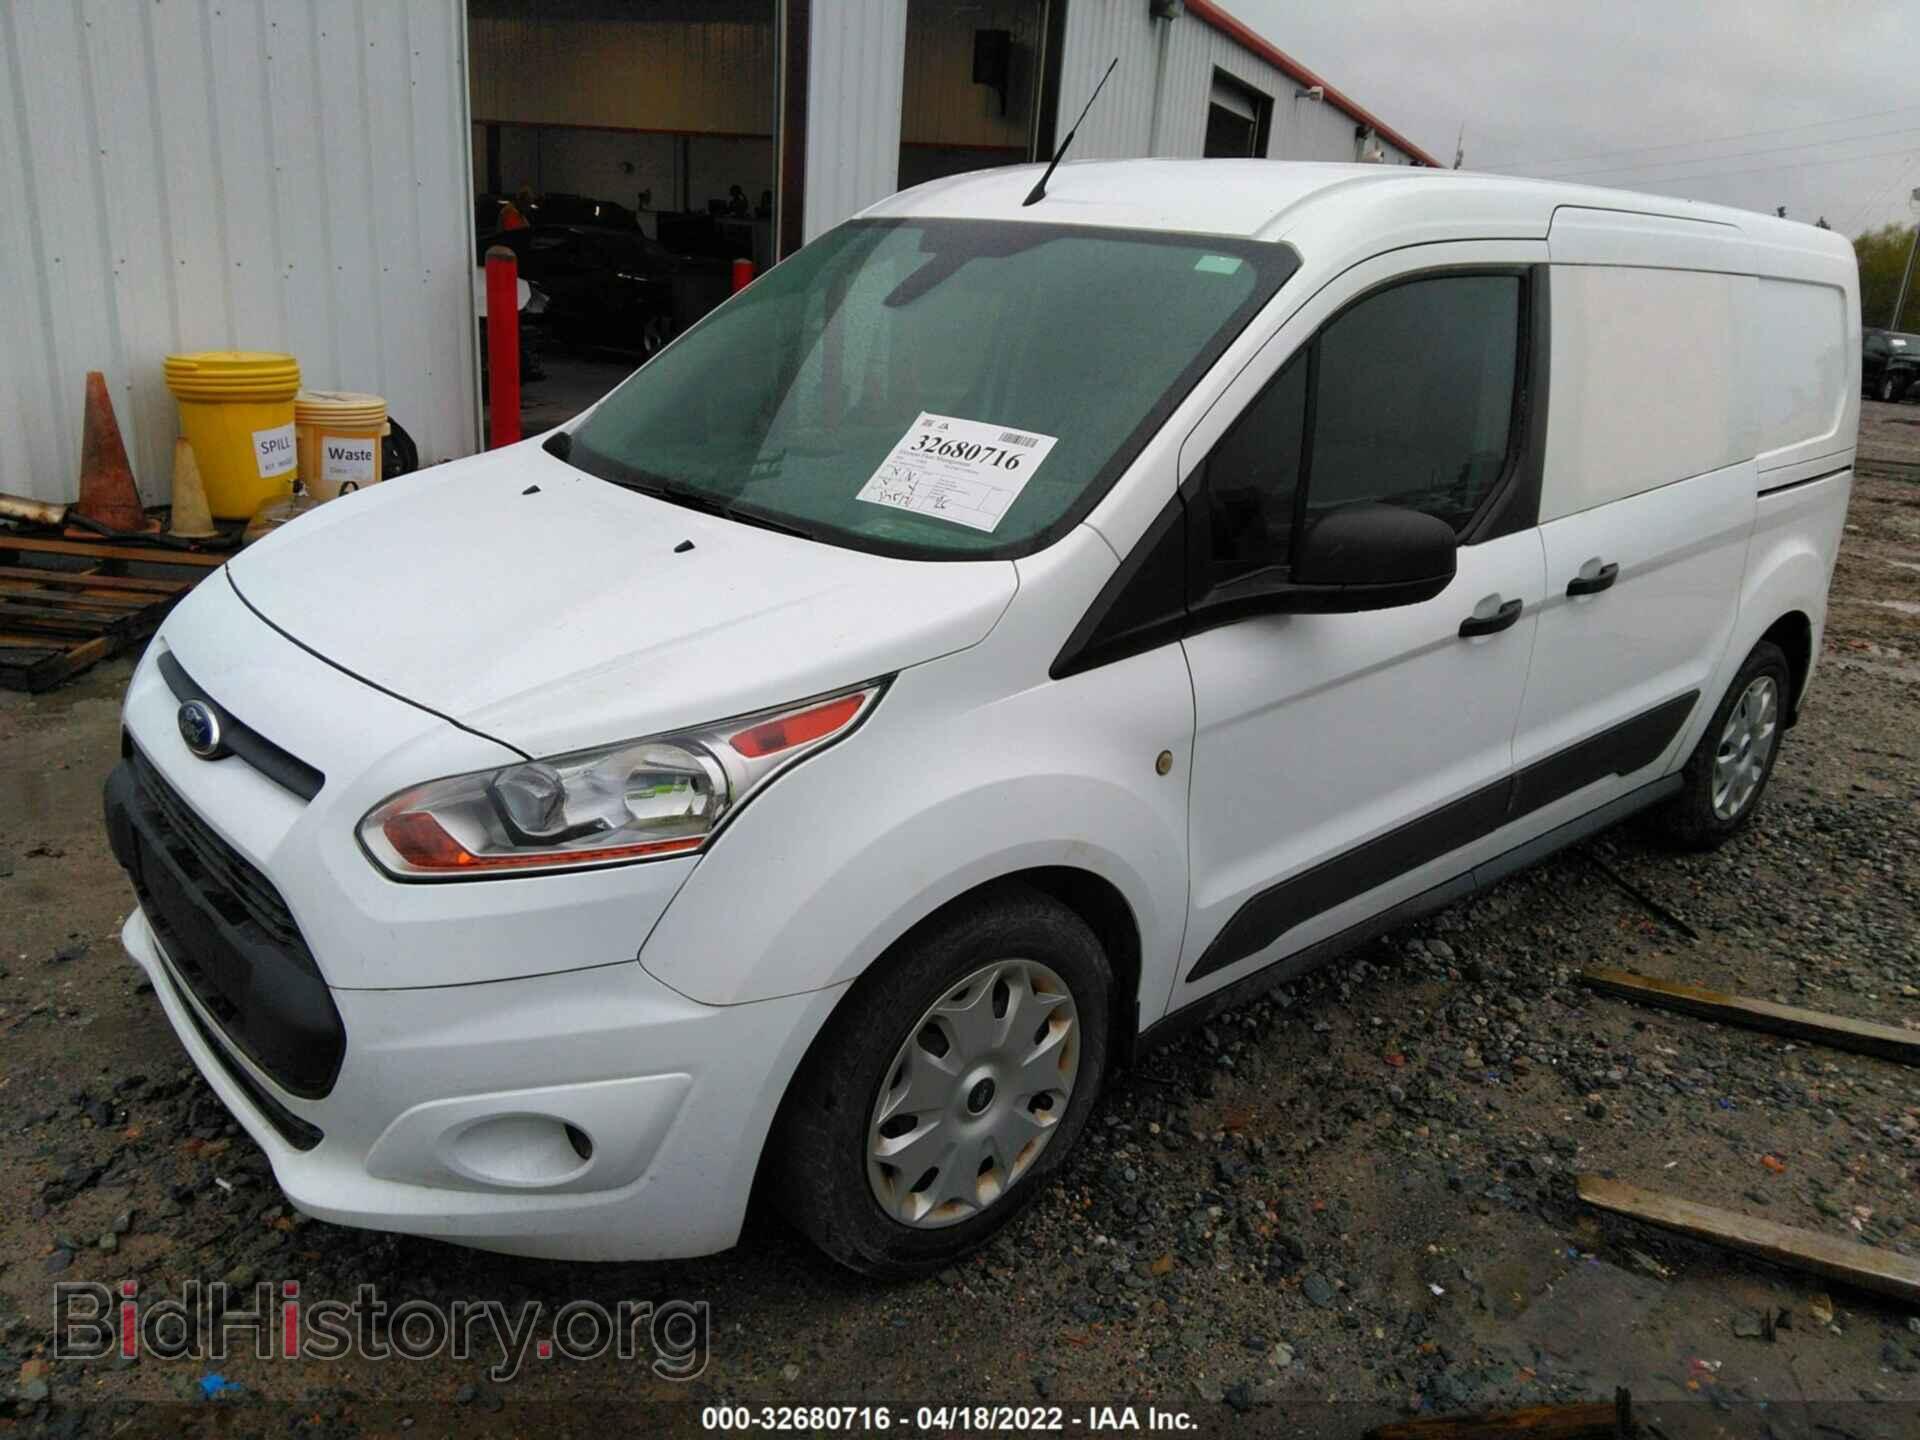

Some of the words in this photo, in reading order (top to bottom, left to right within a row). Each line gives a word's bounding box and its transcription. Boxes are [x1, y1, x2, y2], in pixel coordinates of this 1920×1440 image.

[260, 436, 291, 455] SPILL
[328, 447, 372, 461] Waste
[911, 434, 1024, 470] 32680716
